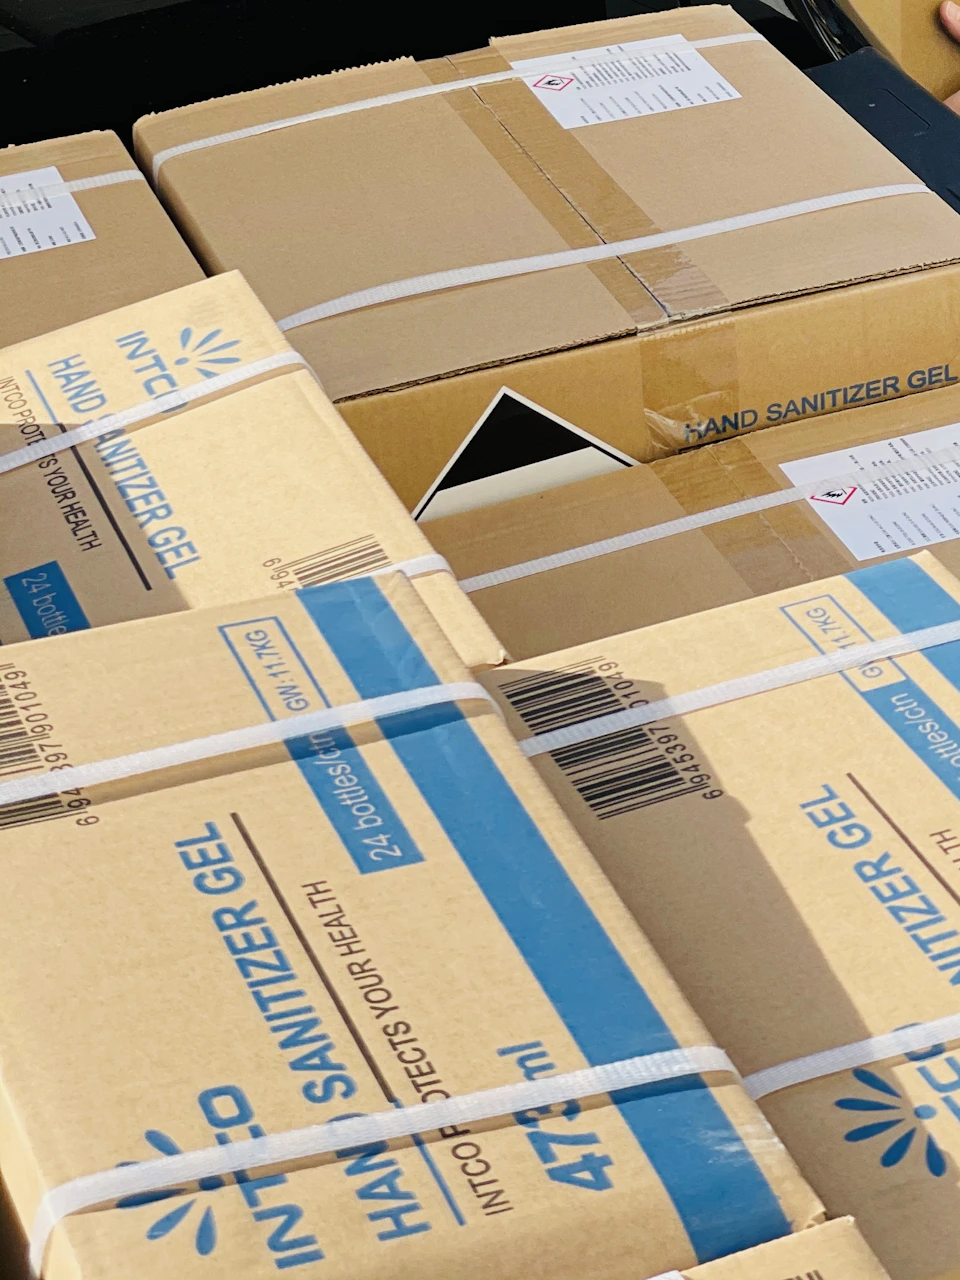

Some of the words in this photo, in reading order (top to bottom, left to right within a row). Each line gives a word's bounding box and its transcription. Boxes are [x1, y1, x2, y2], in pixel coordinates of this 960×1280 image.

[684, 409, 758, 443] HAND
[766, 376, 900, 422] SANITIZER
[907, 364, 959, 389] GEL
[13, 408, 58, 469] PROTETS
[43, 467, 76, 505] YOUR
[60, 501, 102, 551] HEALTH
[47, 353, 107, 413] HAND
[82, 414, 174, 529] ANITIZER
[147, 526, 202, 580] GEL
[21, 572, 51, 593] 24
[309, 733, 384, 831] bottles/ctn
[799, 784, 872, 850] GEL
[173, 821, 246, 896] GEL
[362, 833, 403, 861] 24
[301, 880, 367, 957] HEALTH
[211, 899, 358, 1104] SANITIZER
[346, 957, 400, 1021] YOUR
[451, 1141, 514, 1217] INTCO
